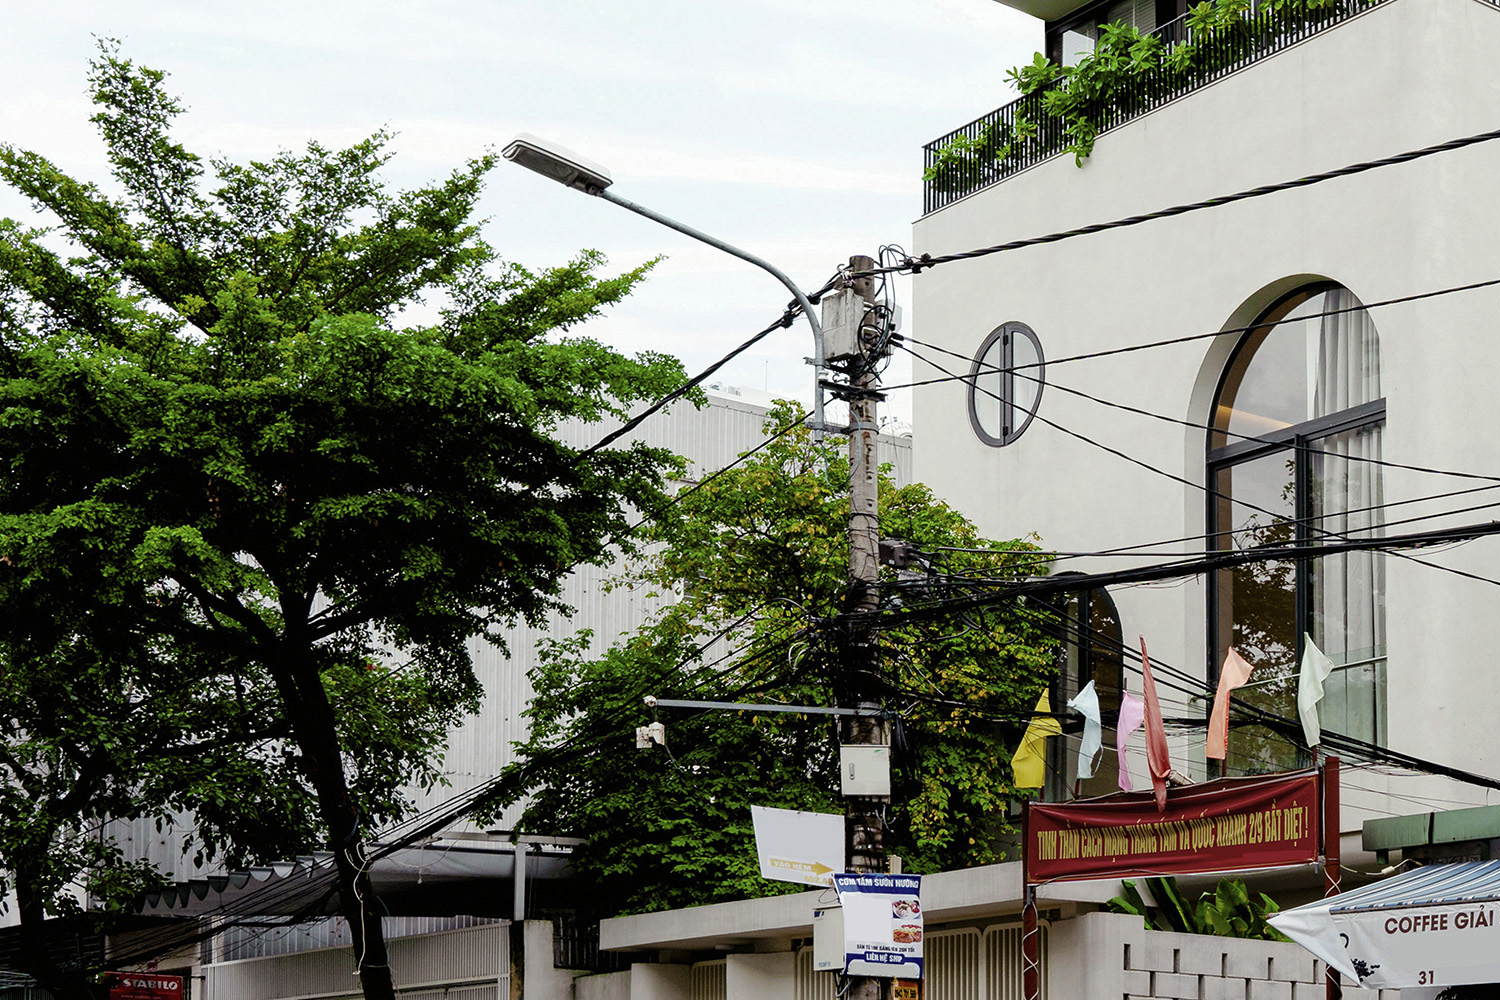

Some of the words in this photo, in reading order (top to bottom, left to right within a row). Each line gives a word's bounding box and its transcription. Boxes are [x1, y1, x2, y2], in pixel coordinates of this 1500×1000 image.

[1038, 830, 1057, 860] TINH
[1081, 822, 1103, 858] CÁCH
[1102, 826, 1129, 863] MẠNG
[1126, 818, 1157, 854] THÁNG
[1154, 817, 1177, 852] TÁM
[1189, 808, 1215, 853] QUỐC
[1248, 811, 1263, 844] 2/9
[1264, 798, 1282, 842] BẤT
[1284, 800, 1303, 847] DIỆT
[1385, 914, 1448, 934] COFFEE
[1454, 905, 1495, 930] GIẢI
[866, 953, 880, 962] LIÊN
[880, 953, 888, 963] HỆ
[889, 955, 903, 963] SHIP
[123, 979, 178, 990] STABILO
[1418, 971, 1434, 985] 31
